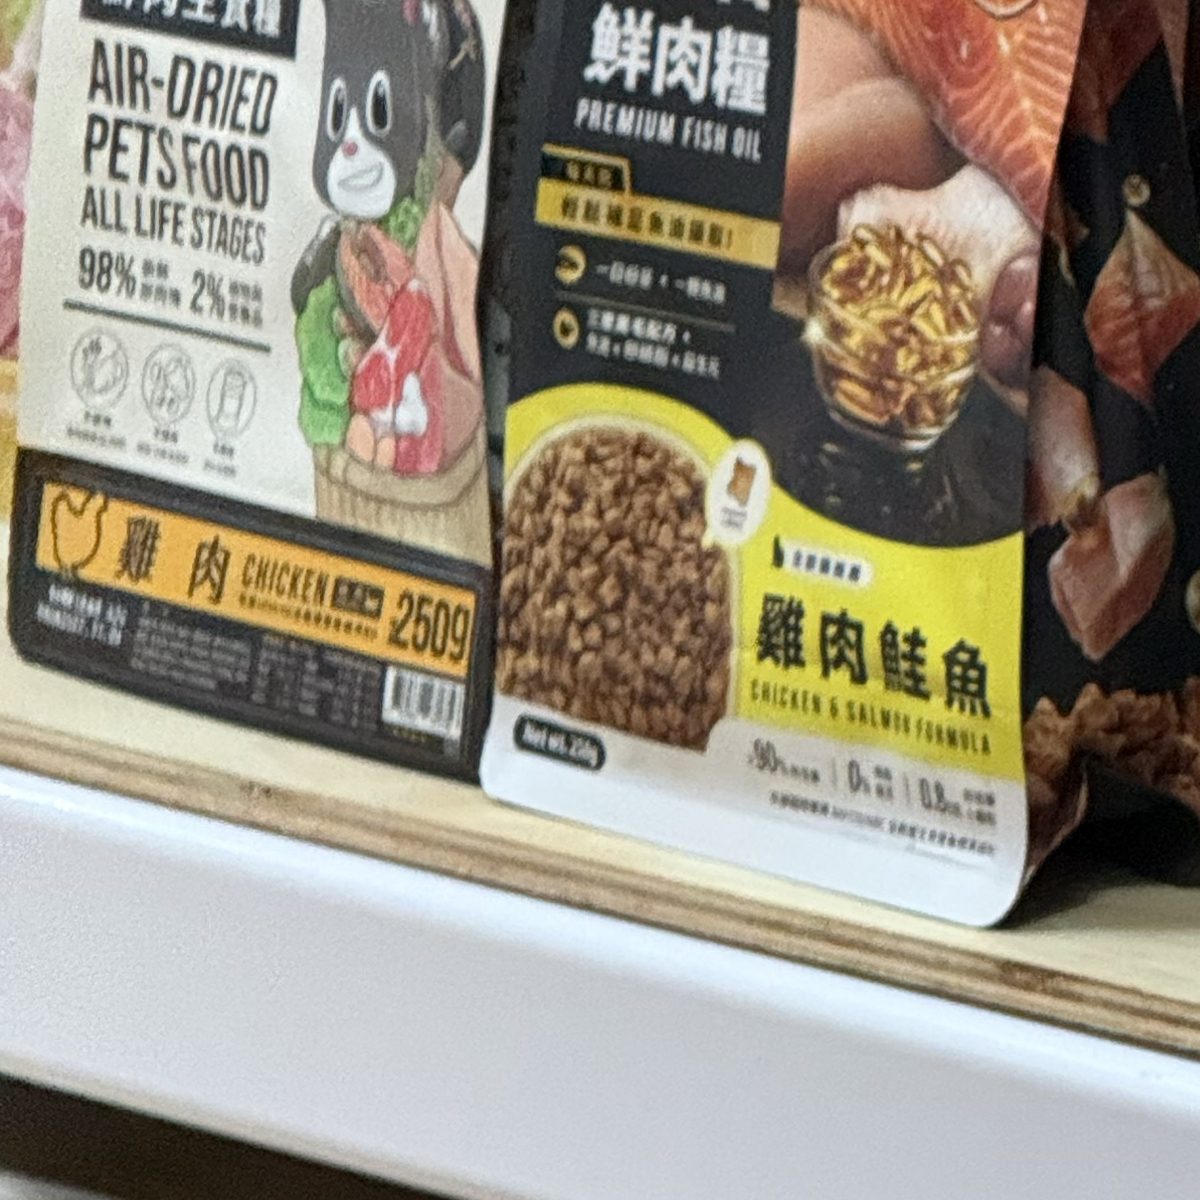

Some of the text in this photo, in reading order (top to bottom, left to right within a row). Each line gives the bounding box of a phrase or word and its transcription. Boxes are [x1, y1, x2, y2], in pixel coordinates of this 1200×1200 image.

[88, 39, 277, 138] AIR-DRIED
[583, 4, 770, 116] 鮮肉糧
[574, 98, 761, 164] PREMIUM FISH OIL
[81, 186, 266, 266] ALL LIFE STAGES
[79, 246, 137, 300] 98%
[190, 268, 226, 320] 2%
[241, 552, 330, 609] CHICKEN
[389, 588, 470, 664] 250g
[756, 592, 992, 720] 雞肉鮭魚
[750, 678, 821, 714] CHICKEN
